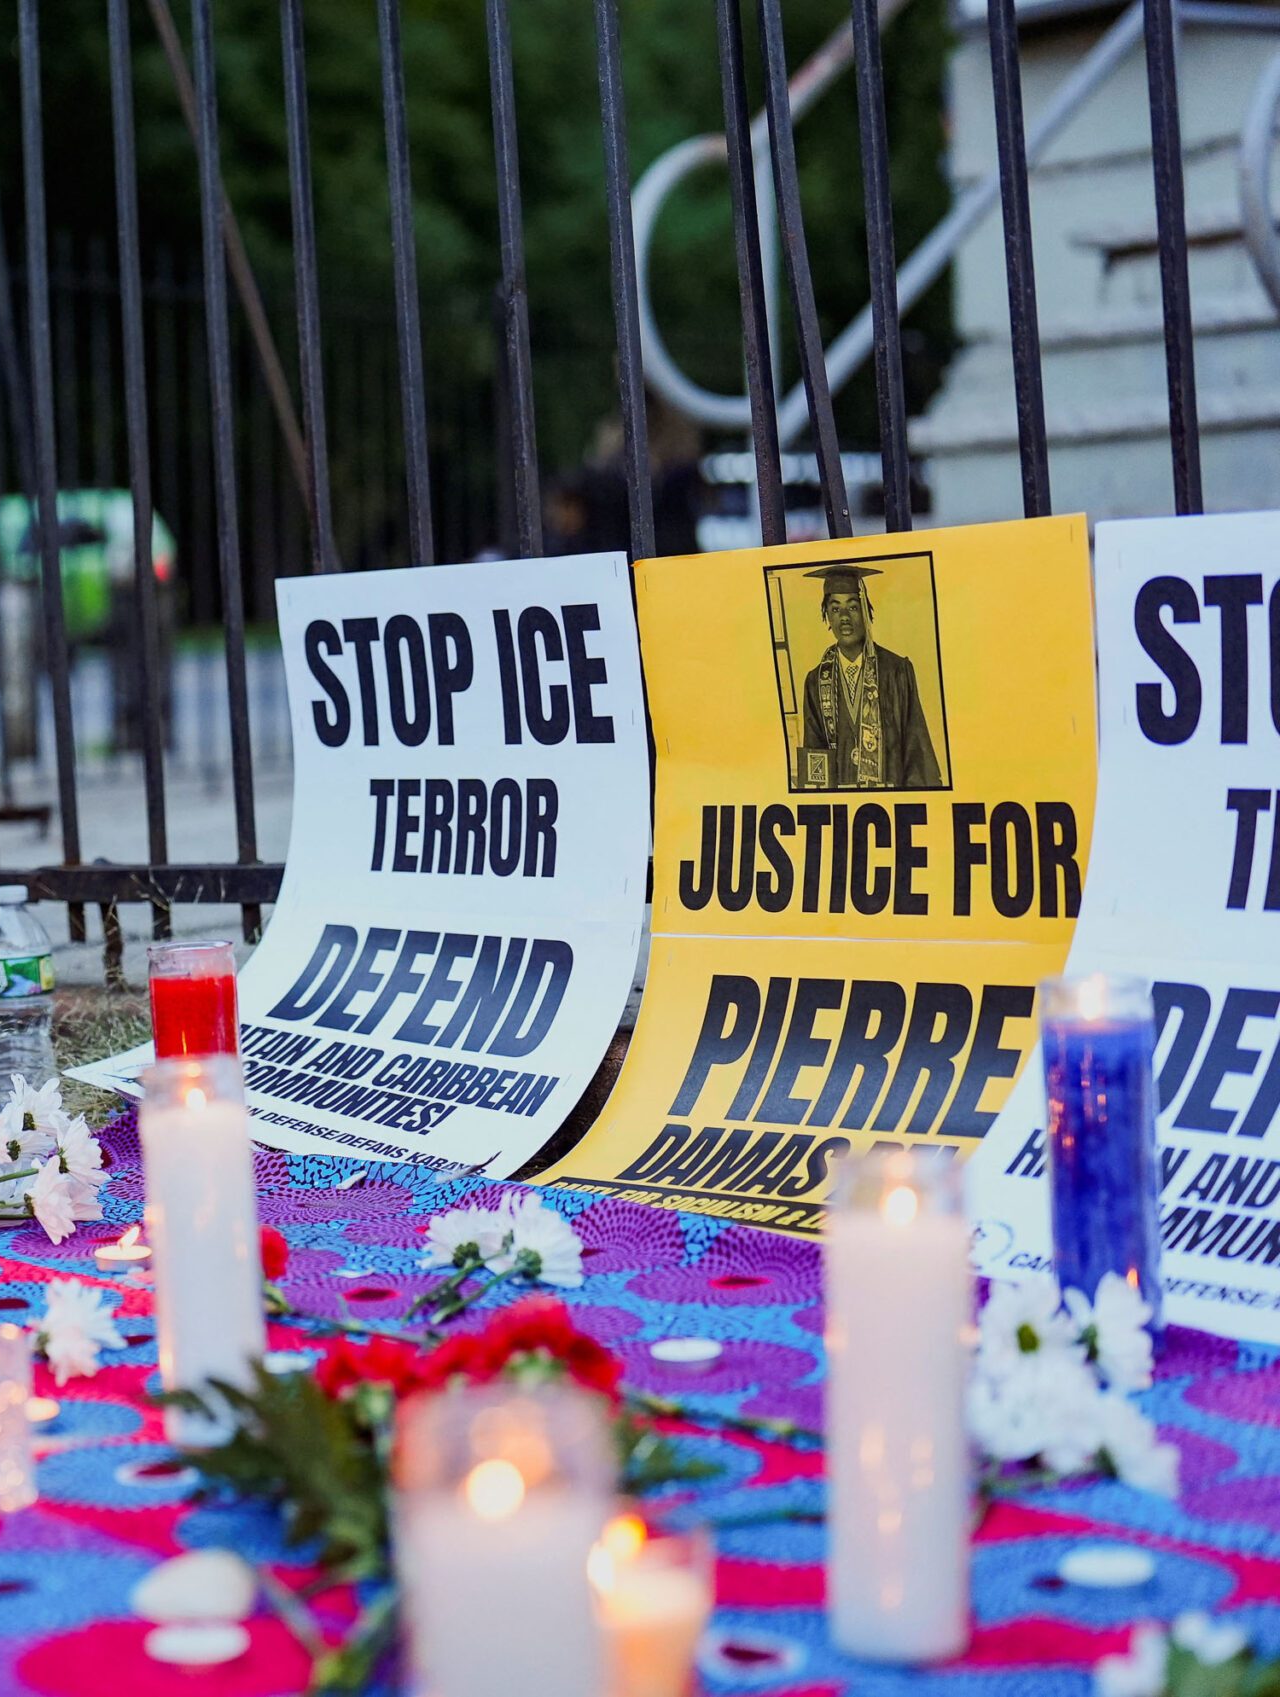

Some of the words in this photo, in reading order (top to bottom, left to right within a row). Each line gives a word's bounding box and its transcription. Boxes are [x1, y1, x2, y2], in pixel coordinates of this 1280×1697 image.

[304, 611, 474, 748] STOP
[492, 603, 616, 746] ICE
[1133, 573, 1280, 747] ST
[369, 777, 559, 879] TERROR
[678, 802, 929, 916] JUSTICE
[952, 801, 1082, 918] FOR
[266, 924, 575, 1058] DEFEND
[301, 1041, 385, 1081] AND
[371, 1053, 560, 1117] CARIBBEAN
[666, 974, 1036, 1139] PIERRE
[613, 1123, 852, 1198] DAMAS
[651, 1194, 790, 1223] SOCIALISM
[775, 1209, 807, 1226] &
[1179, 1152, 1280, 1209] AND
